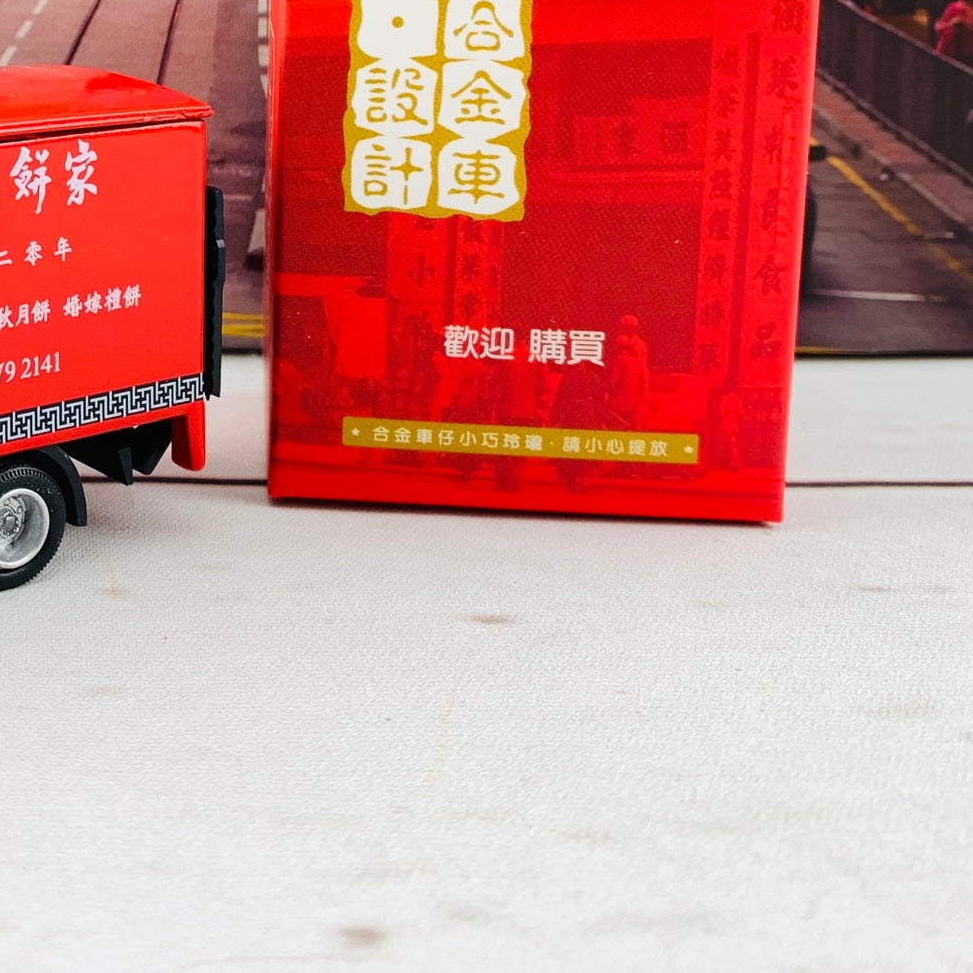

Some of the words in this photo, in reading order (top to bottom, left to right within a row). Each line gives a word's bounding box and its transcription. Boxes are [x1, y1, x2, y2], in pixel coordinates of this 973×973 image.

[62, 283, 142, 318] 婚嫁禮餅
[443, 325, 515, 361] 歡迎
[527, 328, 606, 367] 購買
[20, 351, 62, 380] 2141
